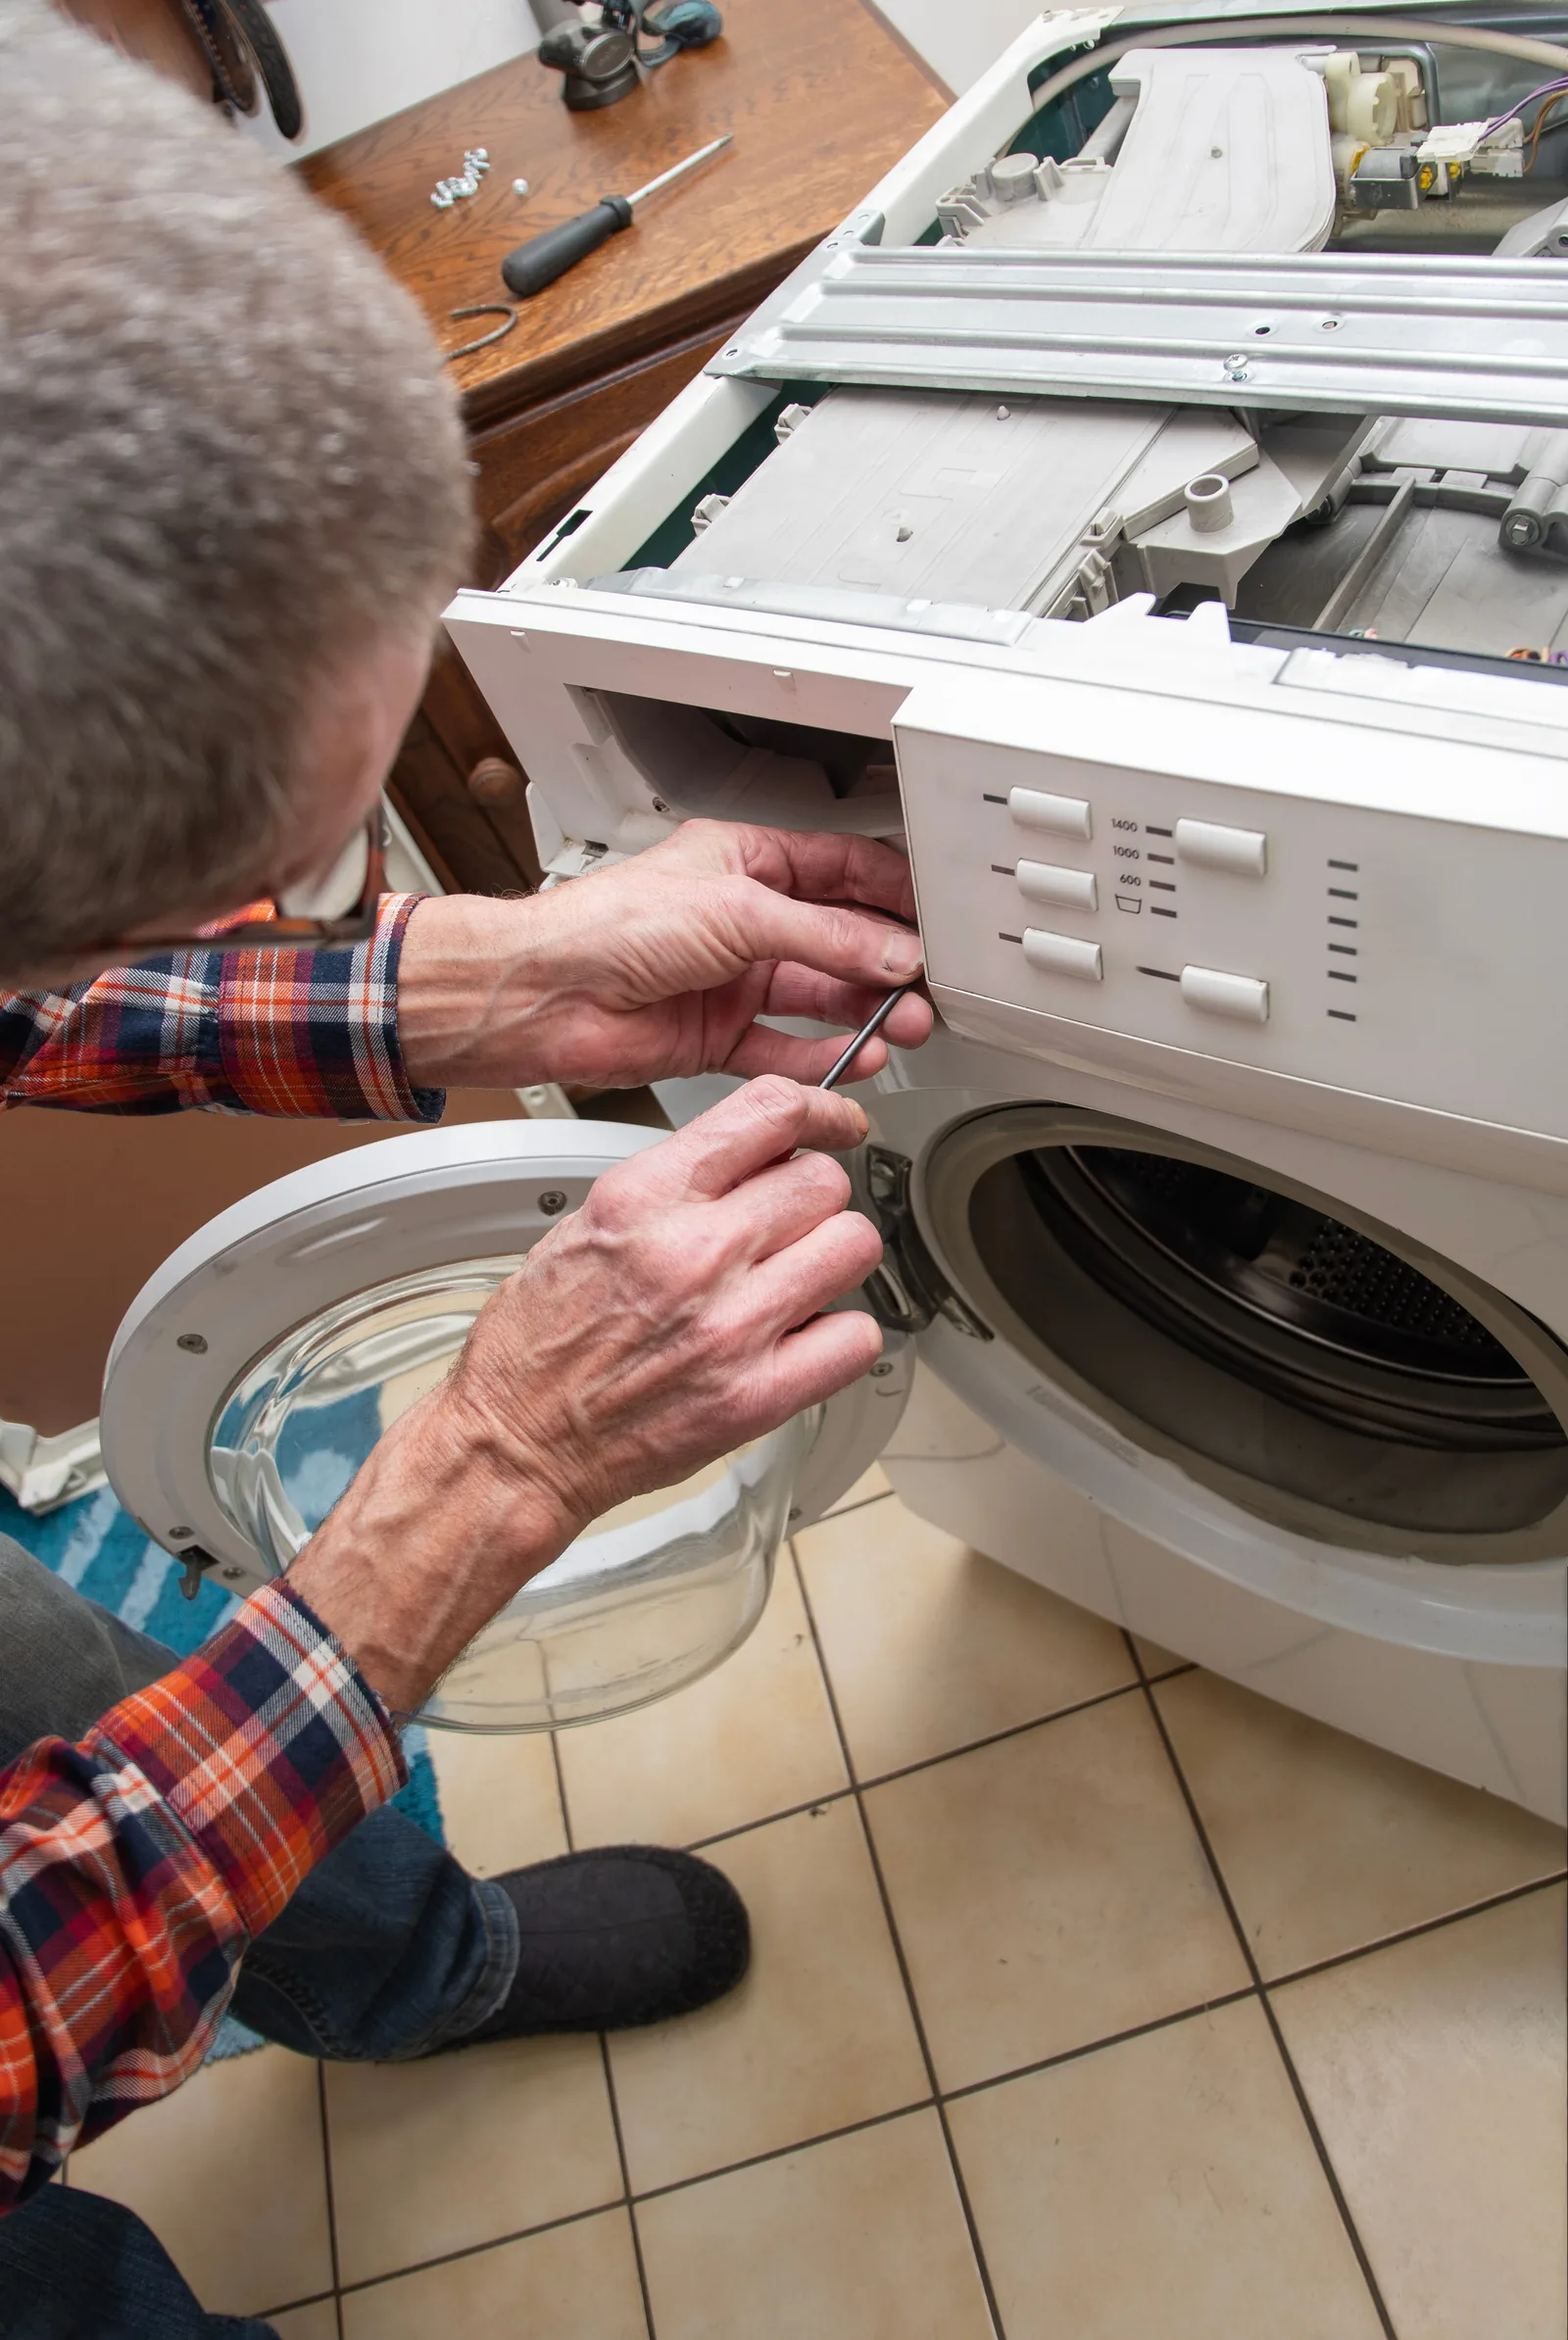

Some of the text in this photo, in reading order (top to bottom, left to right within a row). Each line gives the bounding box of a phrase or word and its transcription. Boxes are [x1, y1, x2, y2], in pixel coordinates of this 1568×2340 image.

[1111, 817, 1138, 833] 1400
[1113, 845, 1140, 859] 1000
[1119, 873, 1142, 887] 600
